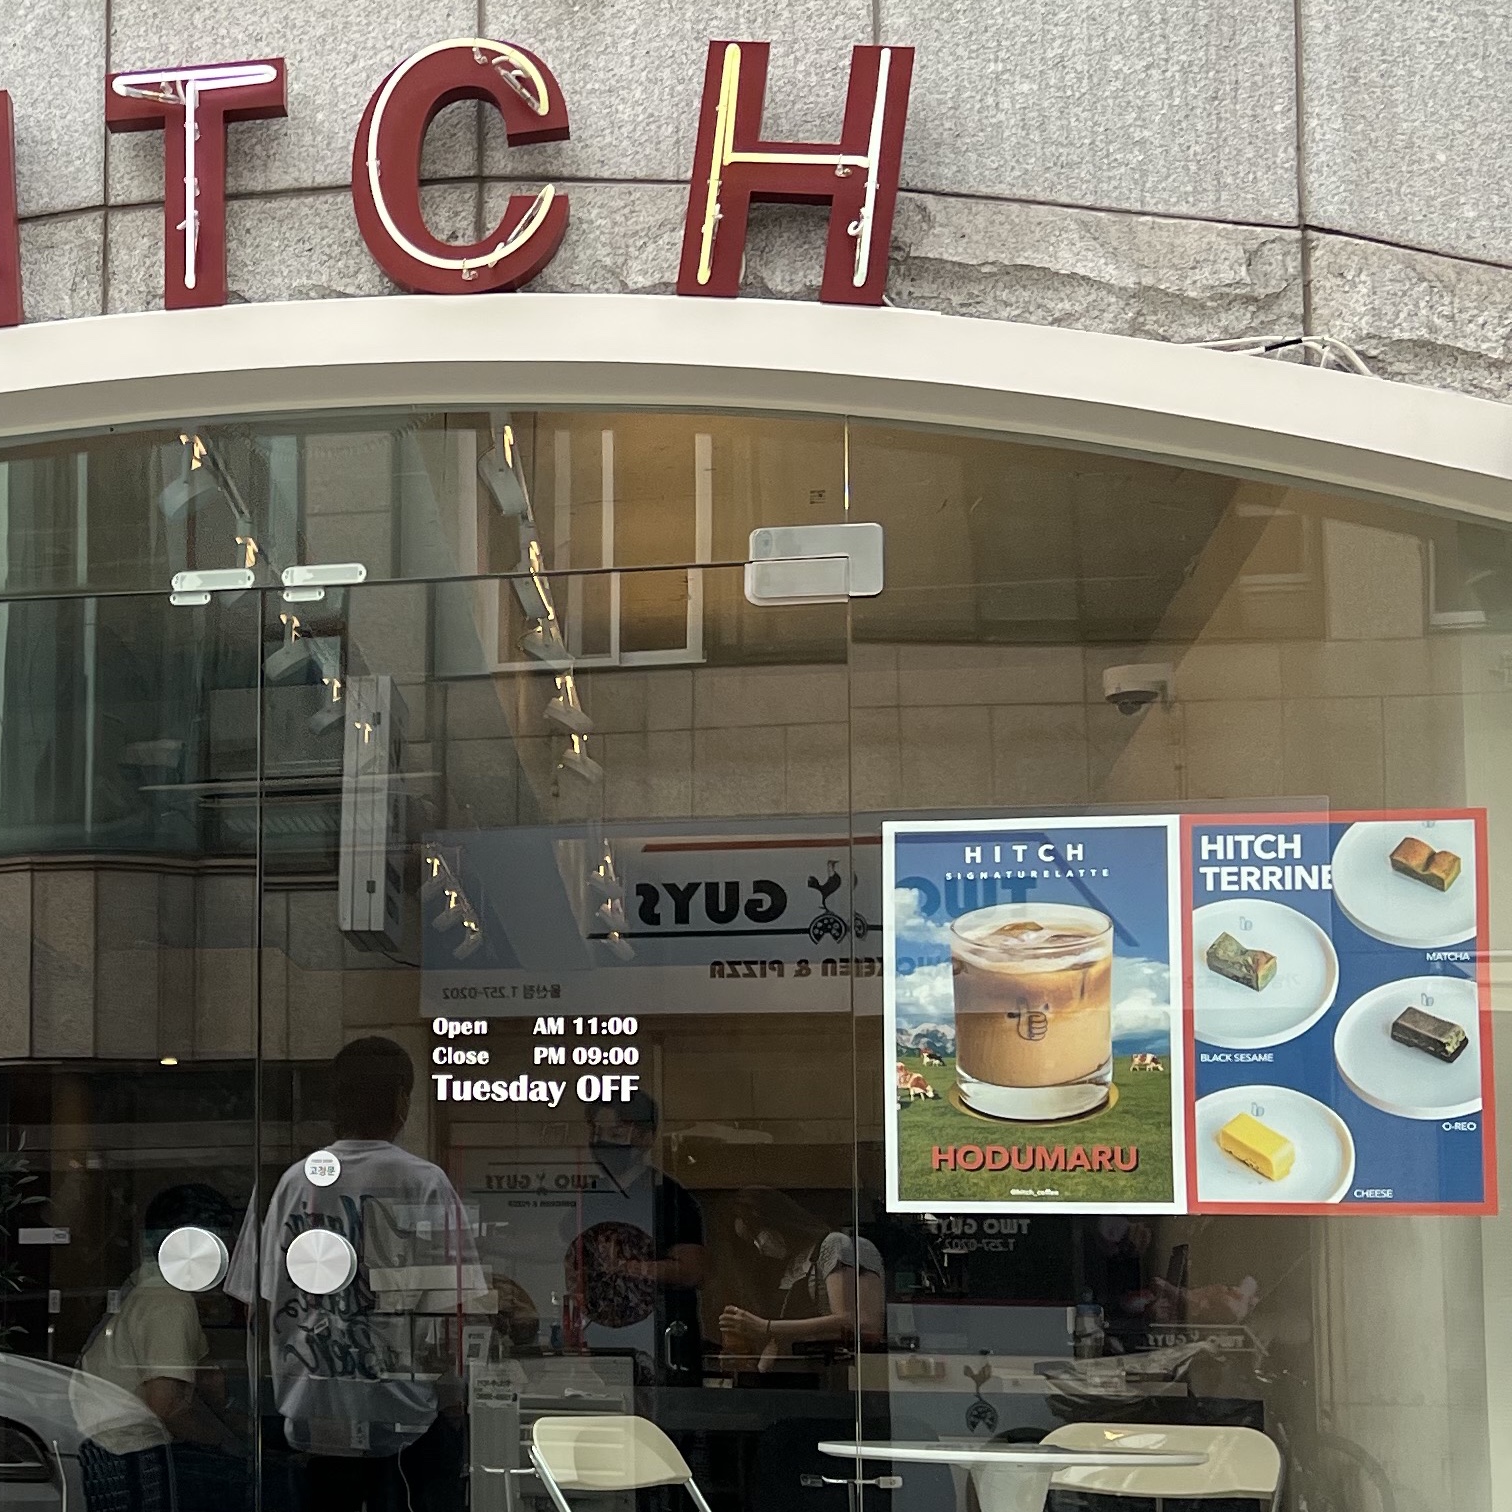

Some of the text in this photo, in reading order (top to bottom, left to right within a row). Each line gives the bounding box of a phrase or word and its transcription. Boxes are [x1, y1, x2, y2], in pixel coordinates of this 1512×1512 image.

[964, 843, 1084, 864] HITCH
[1201, 834, 1302, 860] HITCH
[1426, 952, 1471, 961] MATCHA
[432, 1016, 639, 1038] Open AM 11:00
[432, 1047, 640, 1065] Close PM 09:00
[1200, 1053, 1275, 1062] BLACK SESAME
[431, 1074, 640, 1108] Tuesday OFF
[1441, 1121, 1477, 1131] O-REO
[931, 1144, 1139, 1172] HODUMARU
[1353, 1188, 1394, 1198] CHEESE
